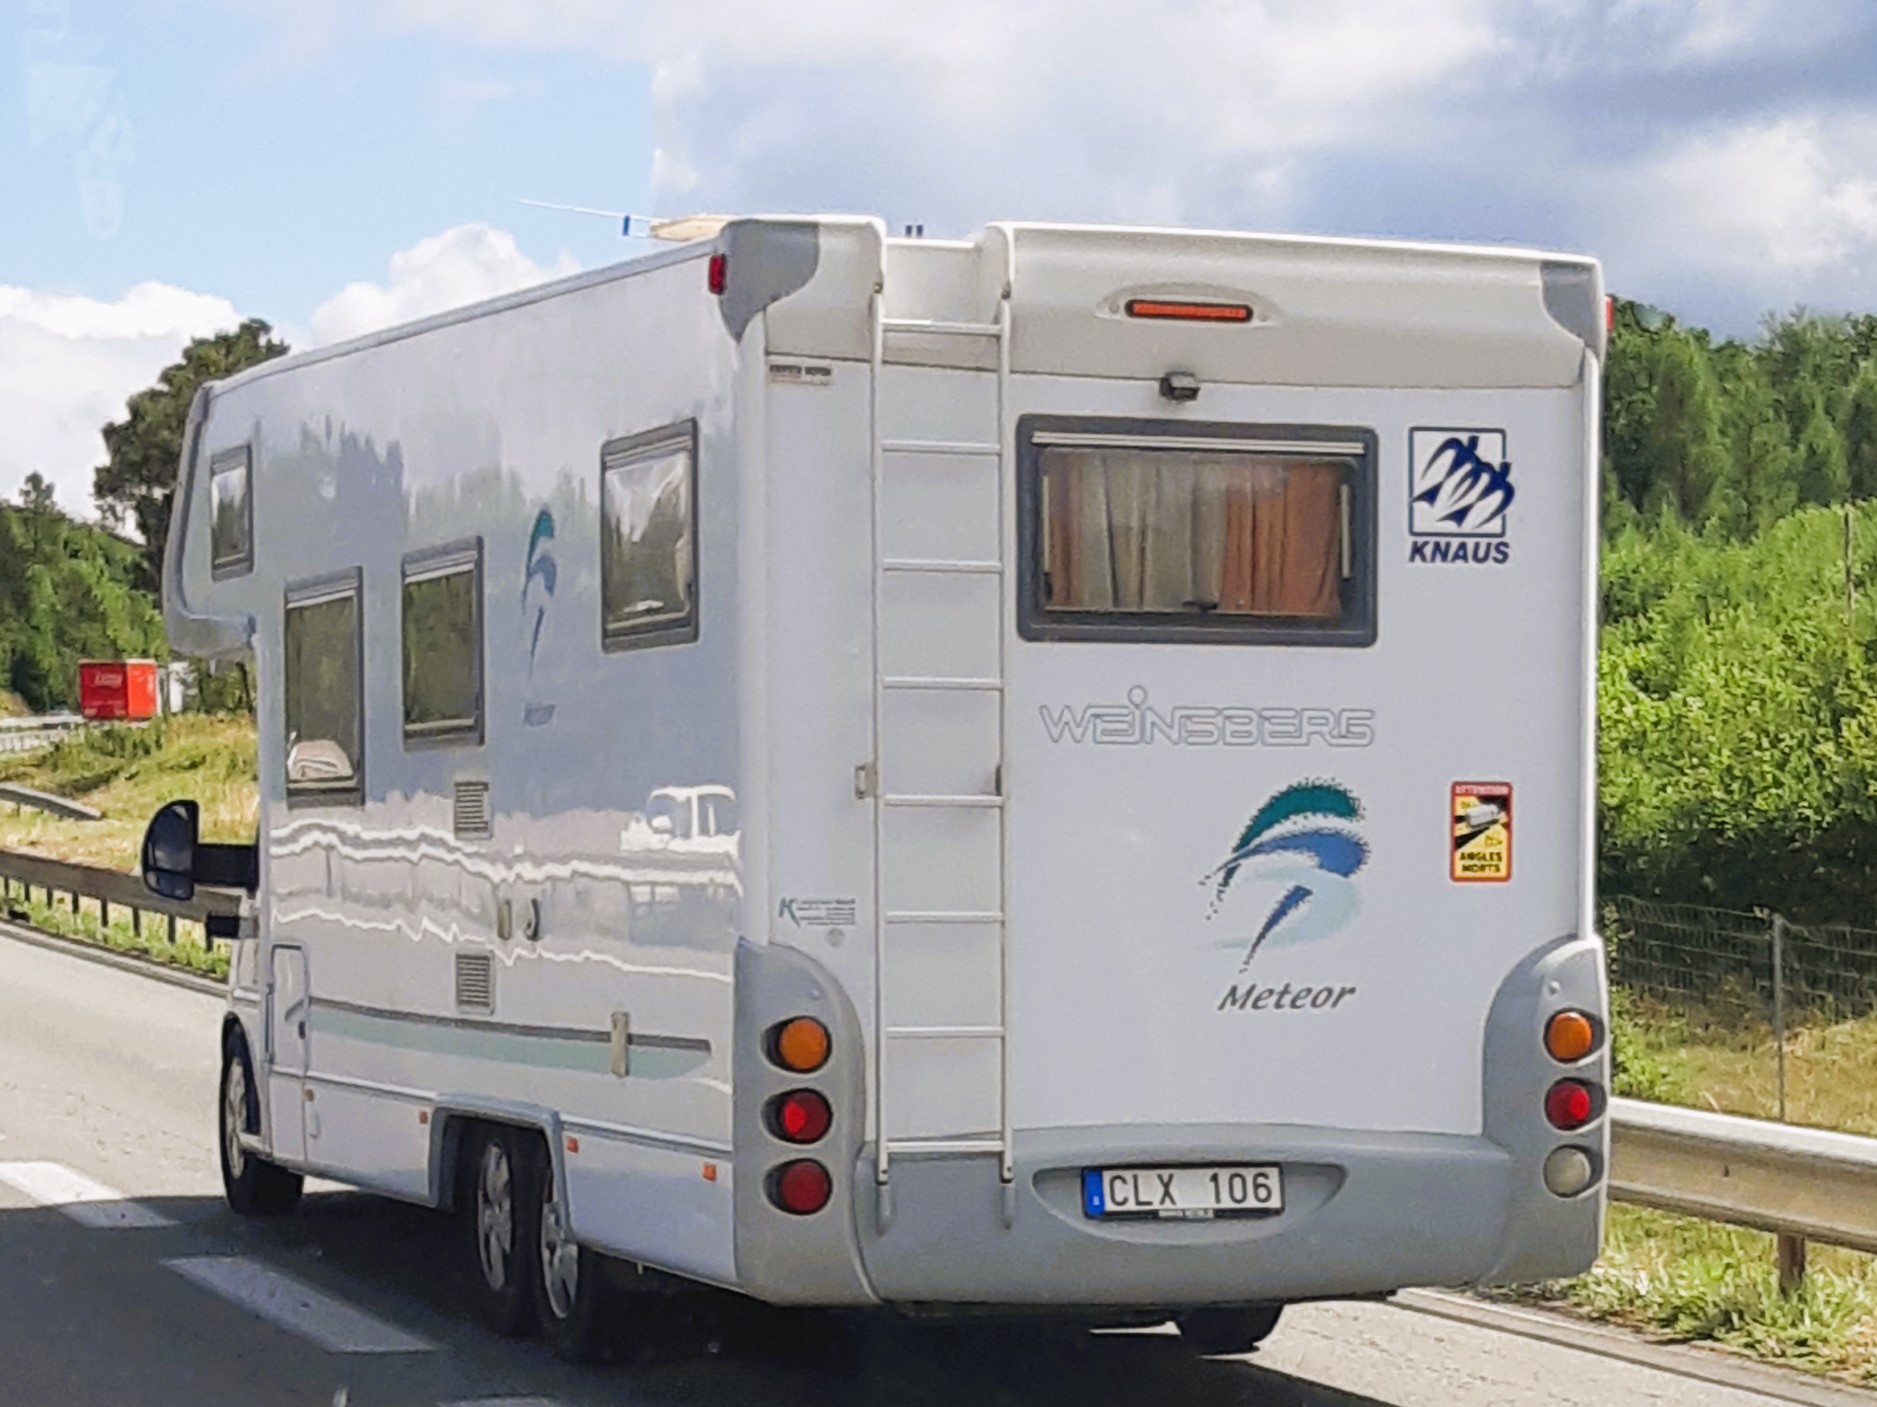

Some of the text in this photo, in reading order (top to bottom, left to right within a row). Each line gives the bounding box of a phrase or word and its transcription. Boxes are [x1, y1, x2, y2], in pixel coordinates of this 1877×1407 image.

[1409, 541, 1510, 564] KNAUS
[1459, 852, 1502, 862] ANGLES
[1217, 982, 1357, 1011] Meteor
[1109, 1172, 1272, 1206] CLX 106
